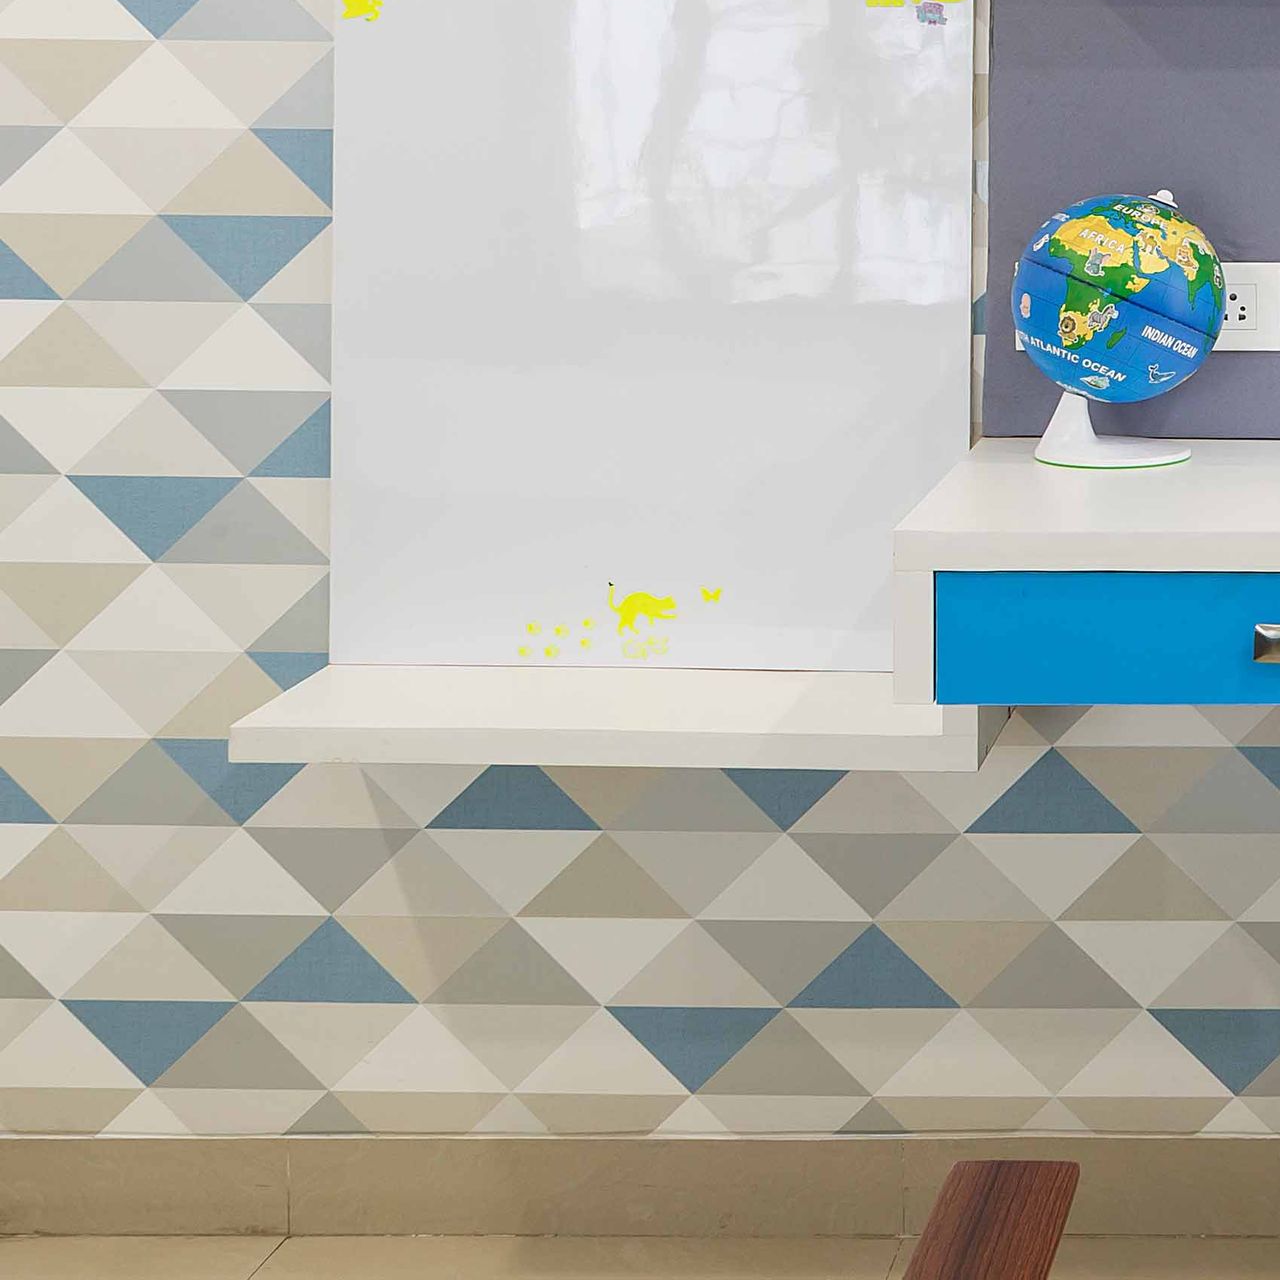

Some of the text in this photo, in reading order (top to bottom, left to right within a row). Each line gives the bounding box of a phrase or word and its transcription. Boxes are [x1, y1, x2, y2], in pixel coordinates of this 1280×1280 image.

[1113, 203, 1168, 230] EUROPE
[1079, 228, 1125, 254] AFRICA
[1141, 325, 1199, 360] INDIAN OCEAN
[1030, 337, 1127, 382] ATLANTIC OCEAN
